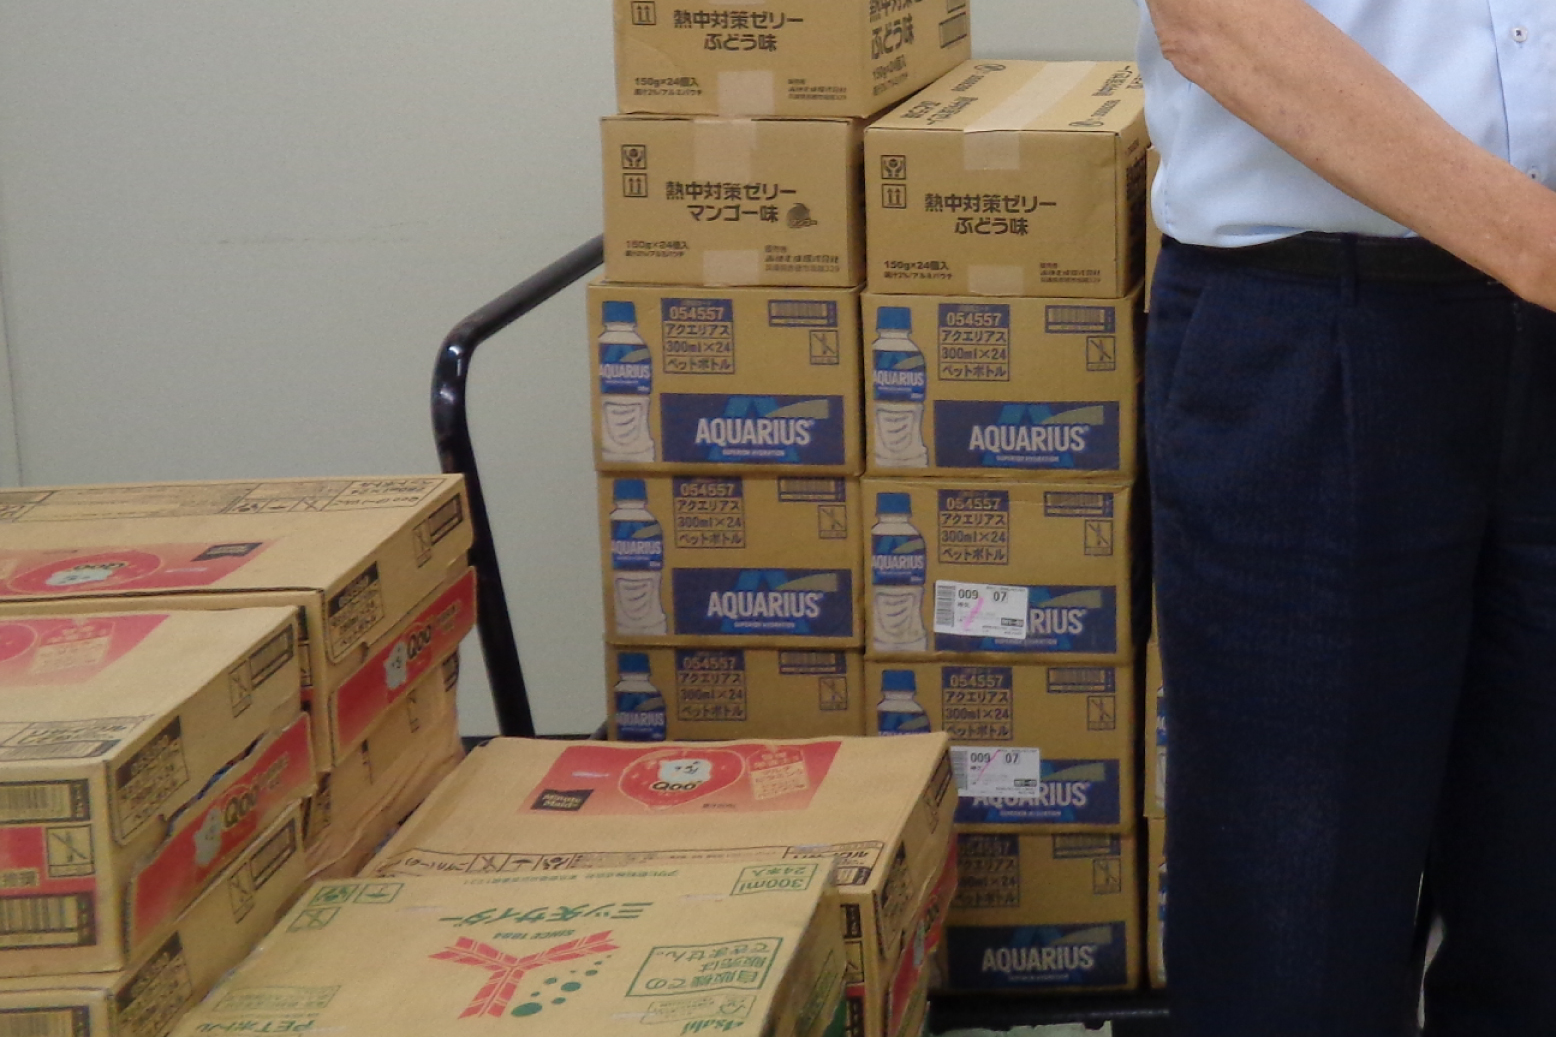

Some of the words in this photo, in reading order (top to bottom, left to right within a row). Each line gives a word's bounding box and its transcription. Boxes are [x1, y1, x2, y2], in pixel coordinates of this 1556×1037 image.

[673, 9, 804, 30] 熱中対策ゼリー
[703, 32, 778, 53] ぶどう味
[665, 180, 797, 201] 熱中対策ゼリー
[924, 192, 1057, 213] 熱中対策ゼリー
[686, 204, 779, 223] マンゴー味
[953, 216, 1029, 236] ぶどう味
[669, 306, 725, 320] 054557
[946, 313, 1002, 327] 054557
[665, 324, 731, 336] アクエリアス
[941, 330, 1006, 343] アクエリアス
[665, 340, 731, 353] 300ml×24
[941, 347, 1007, 360] 300ml×24
[667, 358, 731, 370] ペットボトル
[941, 365, 1006, 378] ペットボトル
[695, 417, 812, 445] AQUARIUS
[969, 425, 1086, 452] AQUARIUS
[680, 483, 734, 497] 054557
[677, 500, 741, 512] アクエリアス
[946, 498, 1001, 511] 054557
[941, 513, 1006, 525] アクエリアス
[679, 533, 742, 545] ペットボトル
[941, 530, 1006, 543] 300ml×24
[941, 548, 1005, 561] ペットボトル
[958, 588, 979, 600] 009
[993, 591, 1008, 603] 07
[707, 591, 821, 619] AQUARIUS
[1026, 608, 1084, 635] RIUS
[680, 672, 742, 684] アクエリアス
[949, 674, 1004, 688] 054557
[945, 691, 1009, 703] アクエリアス
[970, 752, 991, 763] 009
[1005, 752, 1020, 764] 07
[652, 780, 698, 793] Qoo
[739, 878, 804, 893] 300ml
[438, 902, 654, 928] 三ツ矢サイダー
[981, 945, 1094, 972] AQUARIUS
[644, 970, 759, 990] 自販機での
[679, 1018, 744, 1036] Asahi
